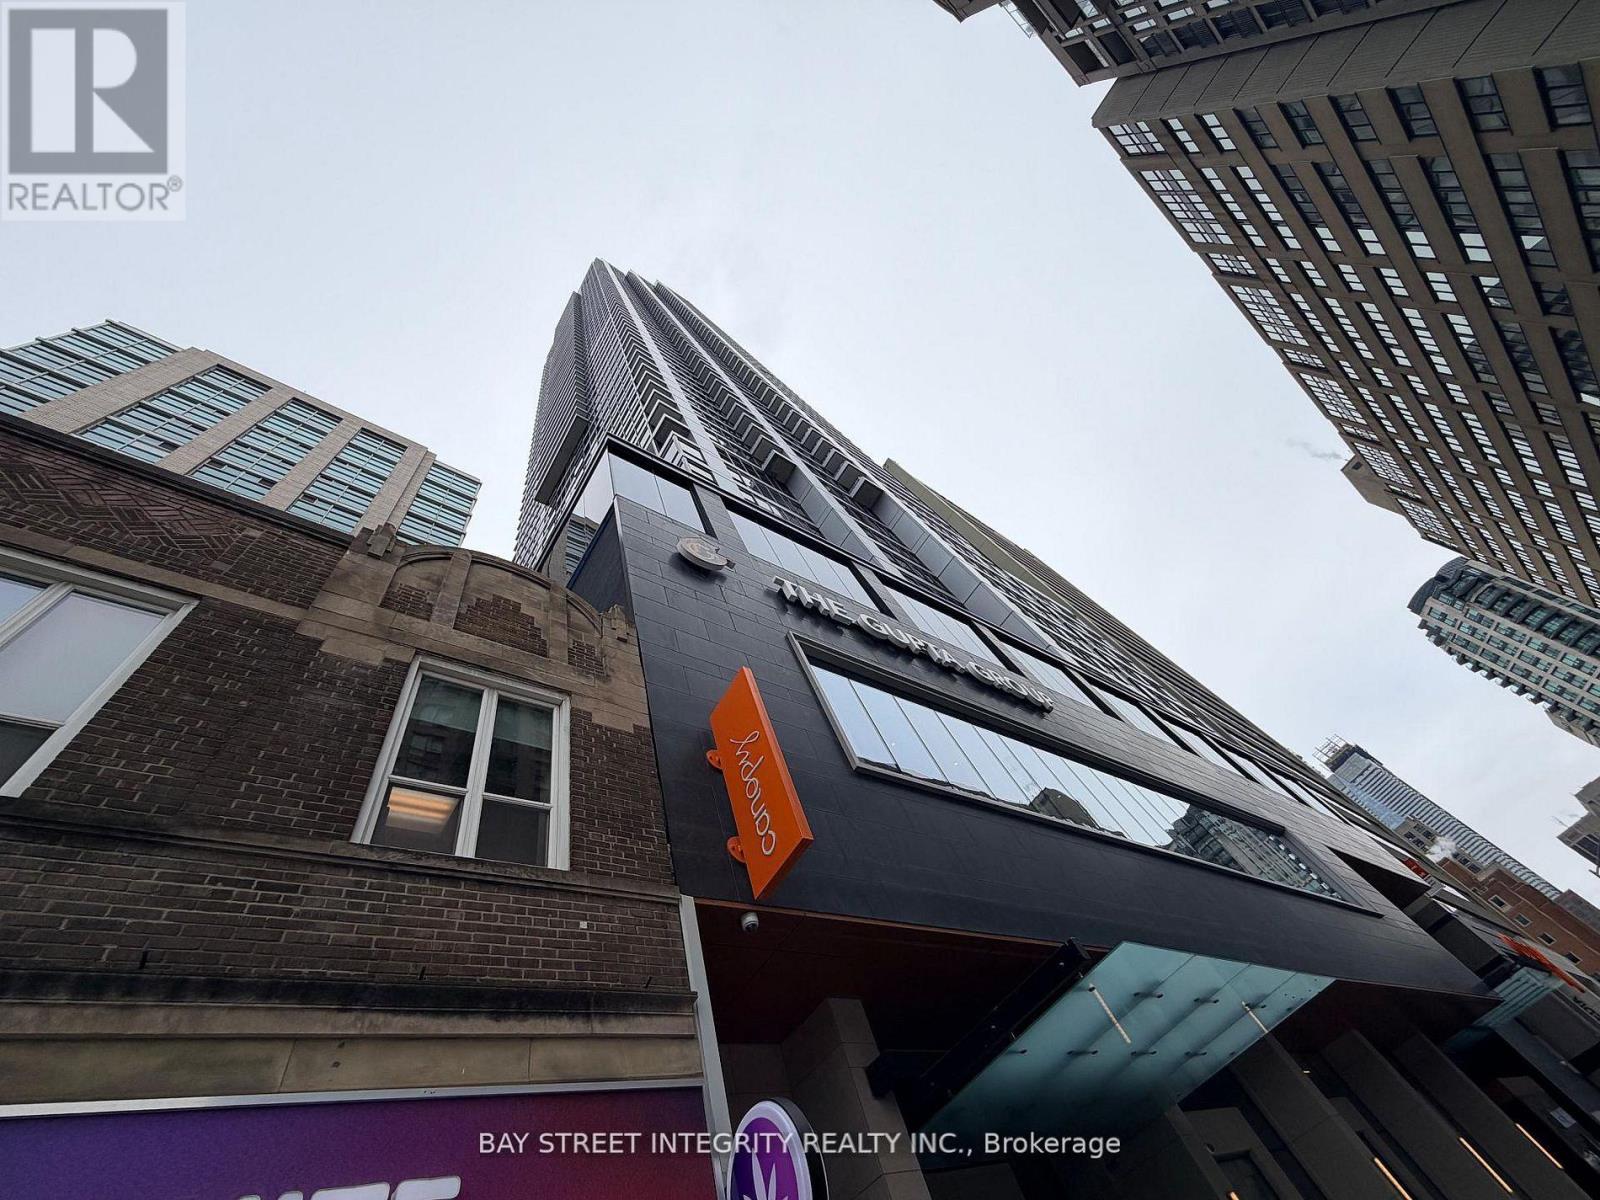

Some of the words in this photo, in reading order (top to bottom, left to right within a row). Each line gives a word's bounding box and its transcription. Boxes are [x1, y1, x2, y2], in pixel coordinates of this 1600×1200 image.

[774, 575, 855, 625] THE
[858, 613, 966, 673] GUPTA
[965, 661, 1055, 713] GROUP
[730, 730, 776, 856] canopy
